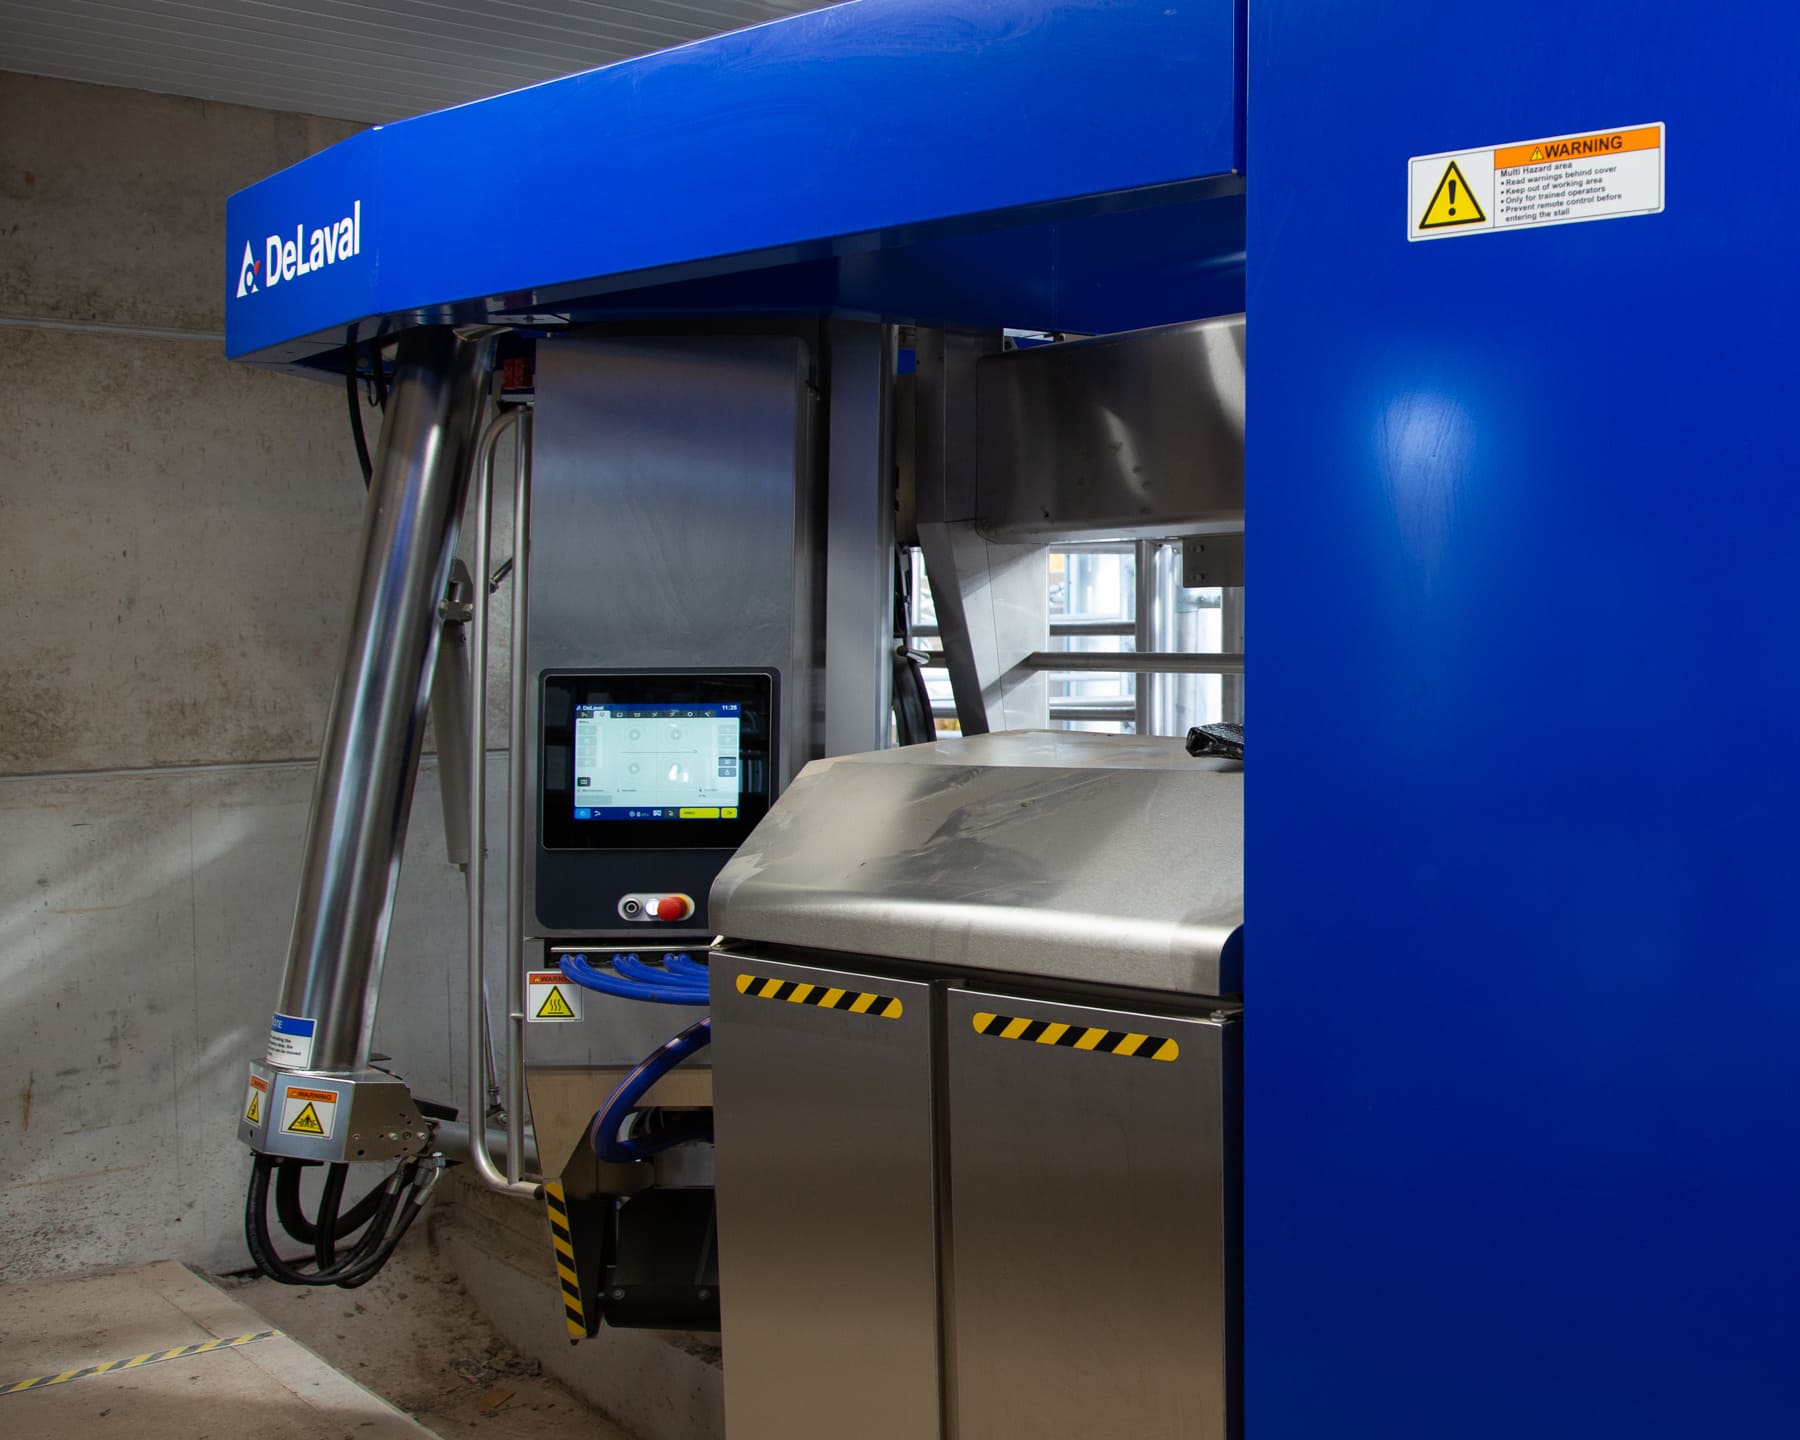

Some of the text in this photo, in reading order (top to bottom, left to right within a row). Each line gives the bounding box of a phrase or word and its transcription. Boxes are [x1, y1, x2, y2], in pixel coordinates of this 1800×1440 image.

[1545, 136, 1622, 158] WARNING
[1501, 162, 1573, 177] Multi Hazard area
[1506, 166, 1617, 186] Read warnings behind cover
[1506, 187, 1525, 196] Keep
[1542, 183, 1550, 191] of
[1552, 179, 1583, 189] working
[1585, 177, 1603, 185] area
[1506, 185, 1606, 205] Only for trained operators
[1505, 193, 1622, 213] Prevent remote control before
[1505, 212, 1537, 222] entering
[1554, 207, 1570, 216] stall
[266, 199, 361, 288] DeLaval
[298, 1091, 332, 1101] WARNING
